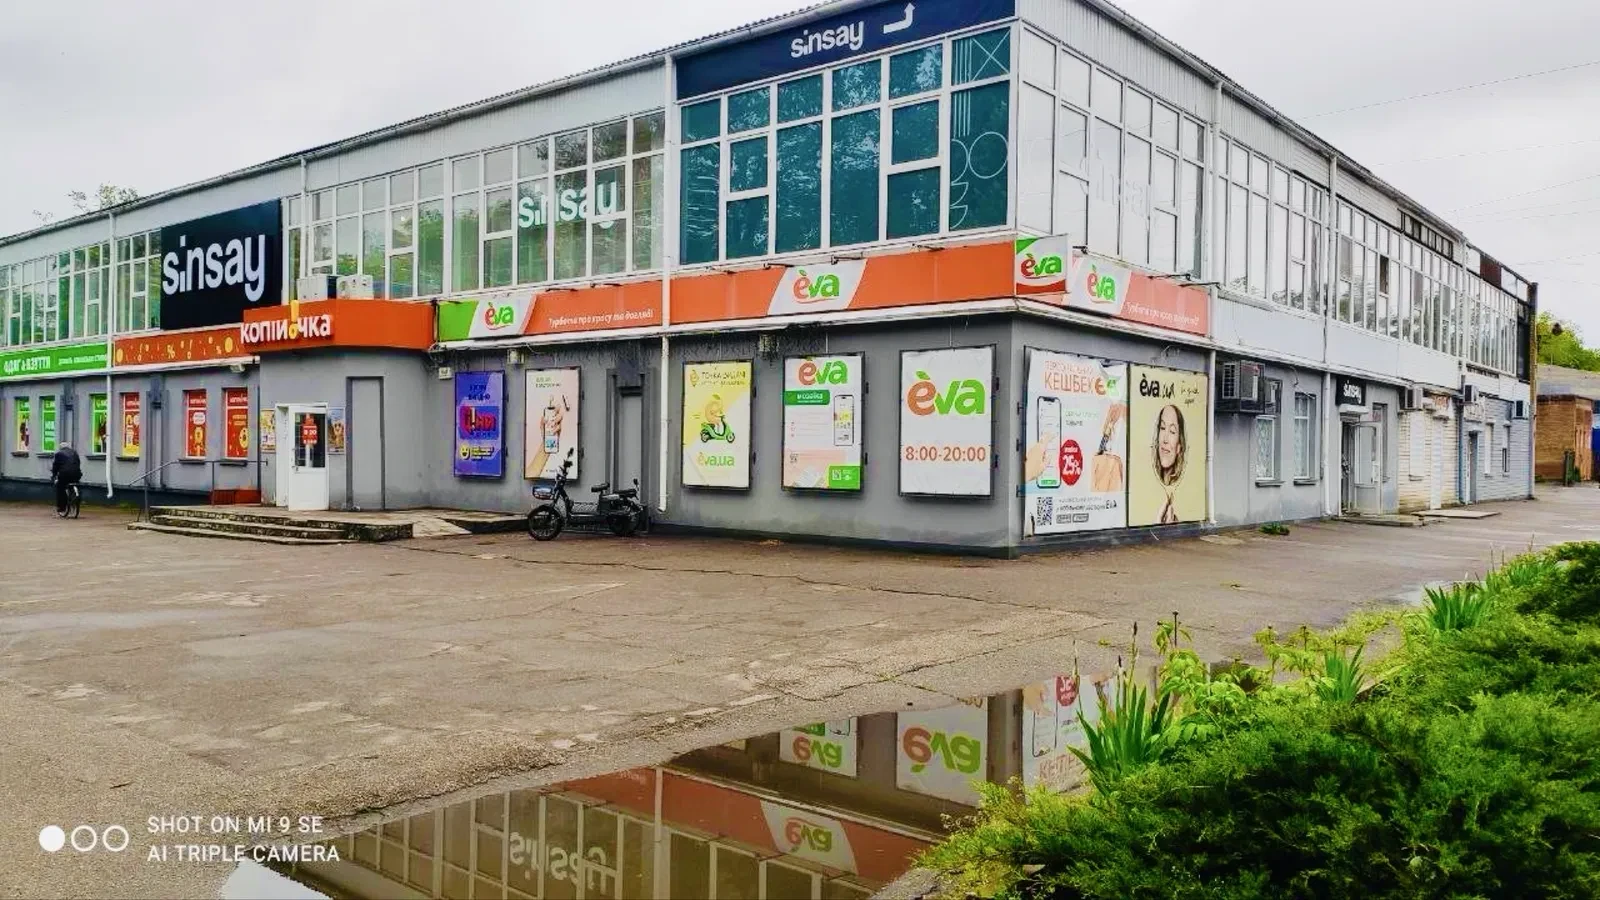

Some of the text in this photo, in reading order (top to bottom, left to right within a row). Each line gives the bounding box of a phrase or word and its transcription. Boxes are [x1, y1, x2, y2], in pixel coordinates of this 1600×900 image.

[791, 21, 865, 58] sinsay
[163, 235, 266, 302] sinsay
[905, 446, 986, 462] 8:00-20:00
